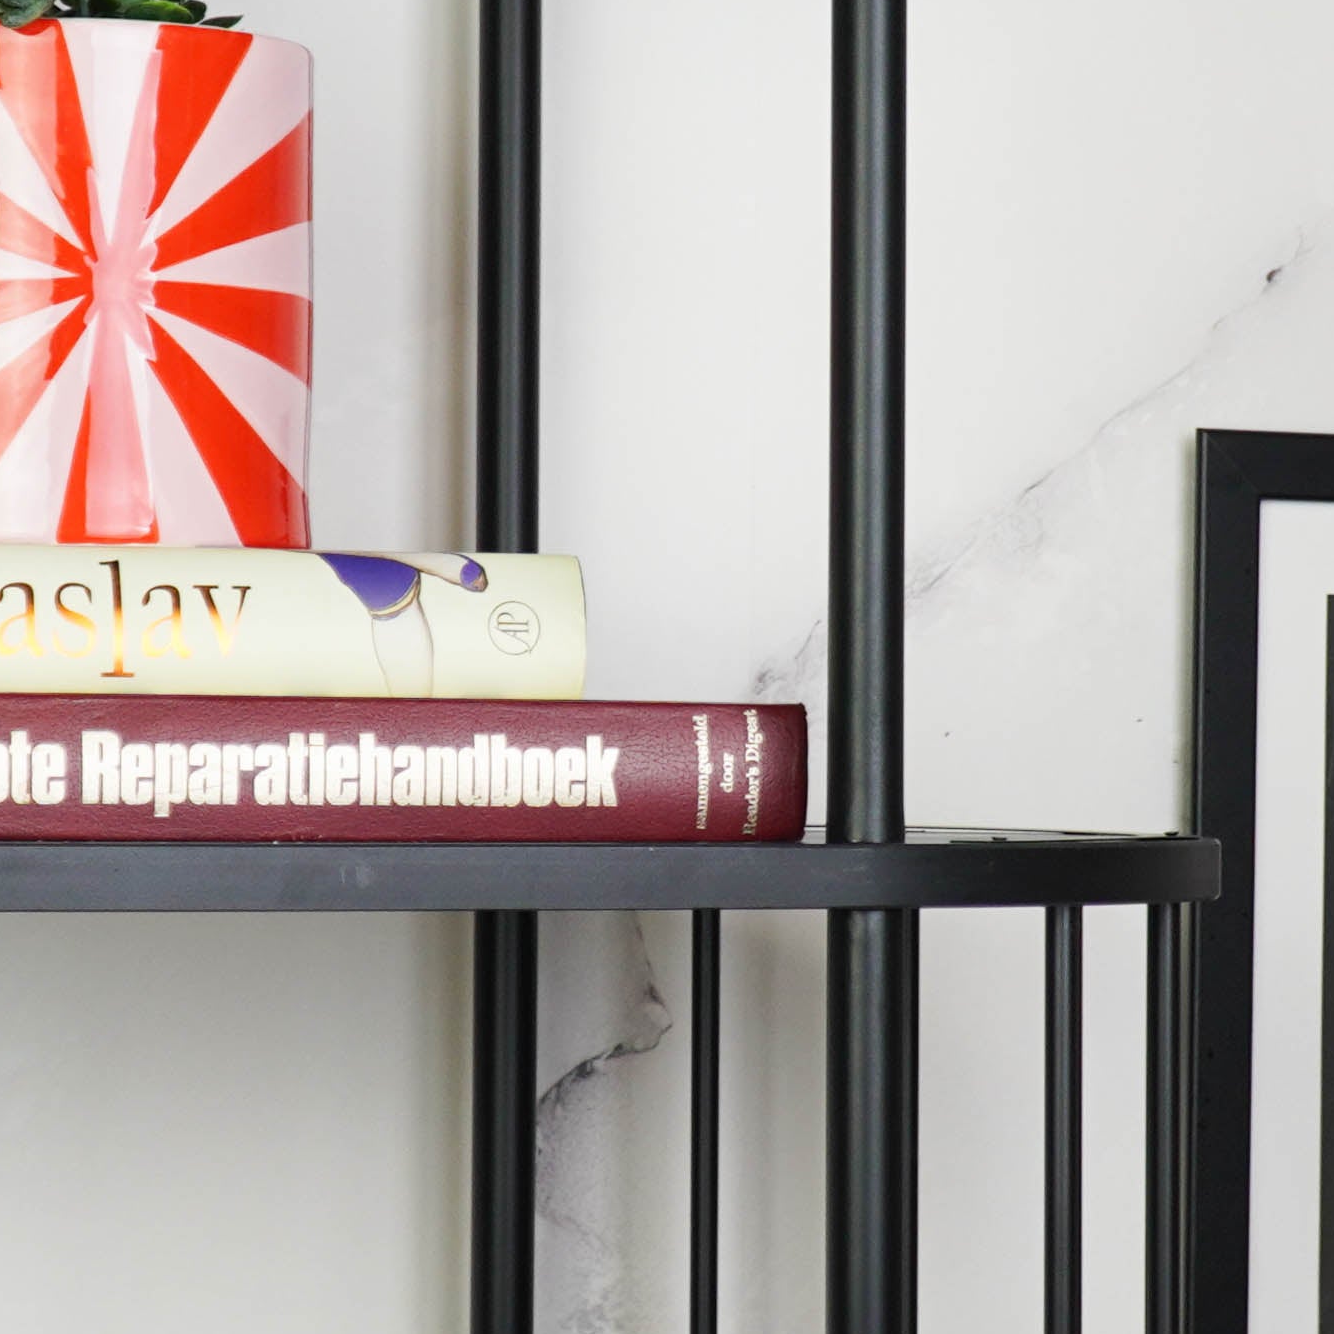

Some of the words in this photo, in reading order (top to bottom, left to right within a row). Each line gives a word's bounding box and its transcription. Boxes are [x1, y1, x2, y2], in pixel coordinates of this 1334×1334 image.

[743, 709, 764, 762] Digest
[81, 729, 620, 819] Reparatiehandboek
[719, 752, 735, 794] door
